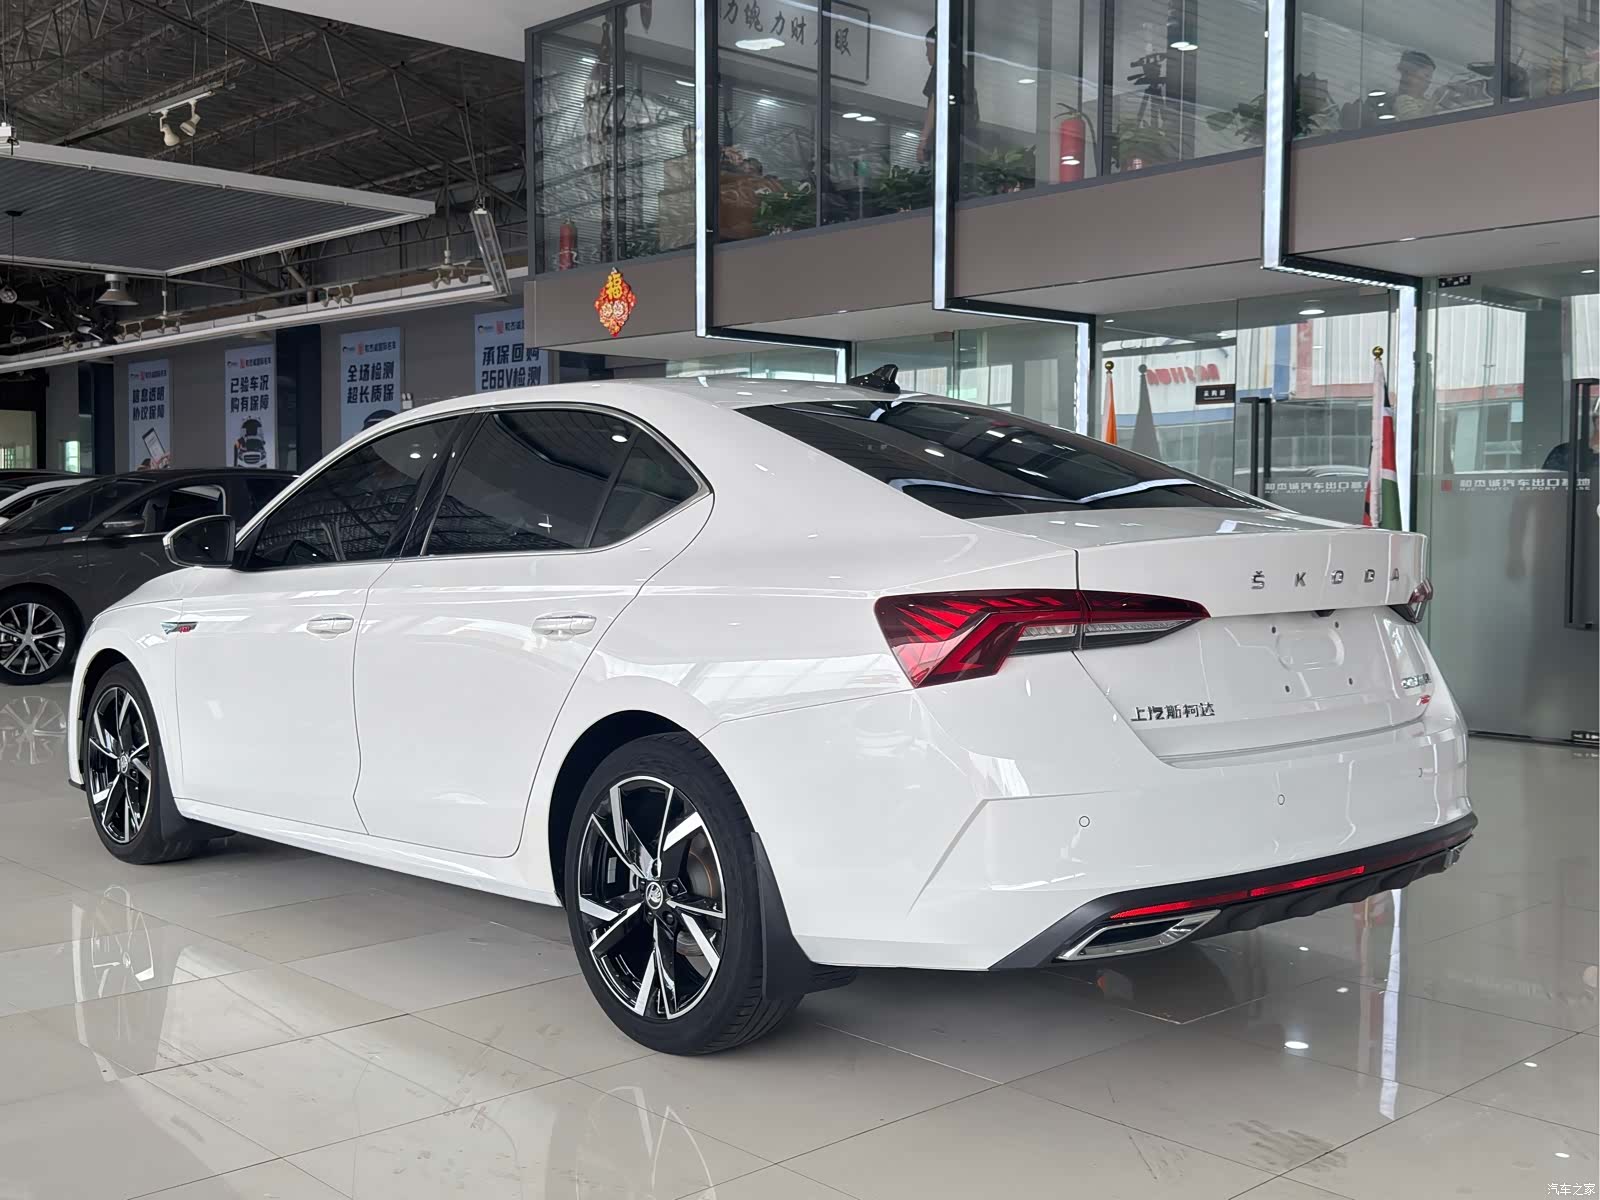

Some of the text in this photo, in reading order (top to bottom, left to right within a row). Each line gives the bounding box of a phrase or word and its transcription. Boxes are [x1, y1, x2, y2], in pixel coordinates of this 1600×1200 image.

[606, 272, 622, 300] 福
[482, 343, 540, 366] 承保回购
[347, 361, 395, 382] 全场检测
[230, 374, 270, 394] 已验车况
[347, 384, 395, 404] 超长质保
[1265, 481, 1367, 490] 和杰诚汽车出口基
[1251, 568, 1400, 590] ŠKODA
[1130, 702, 1215, 722] 上汽斯柯达
